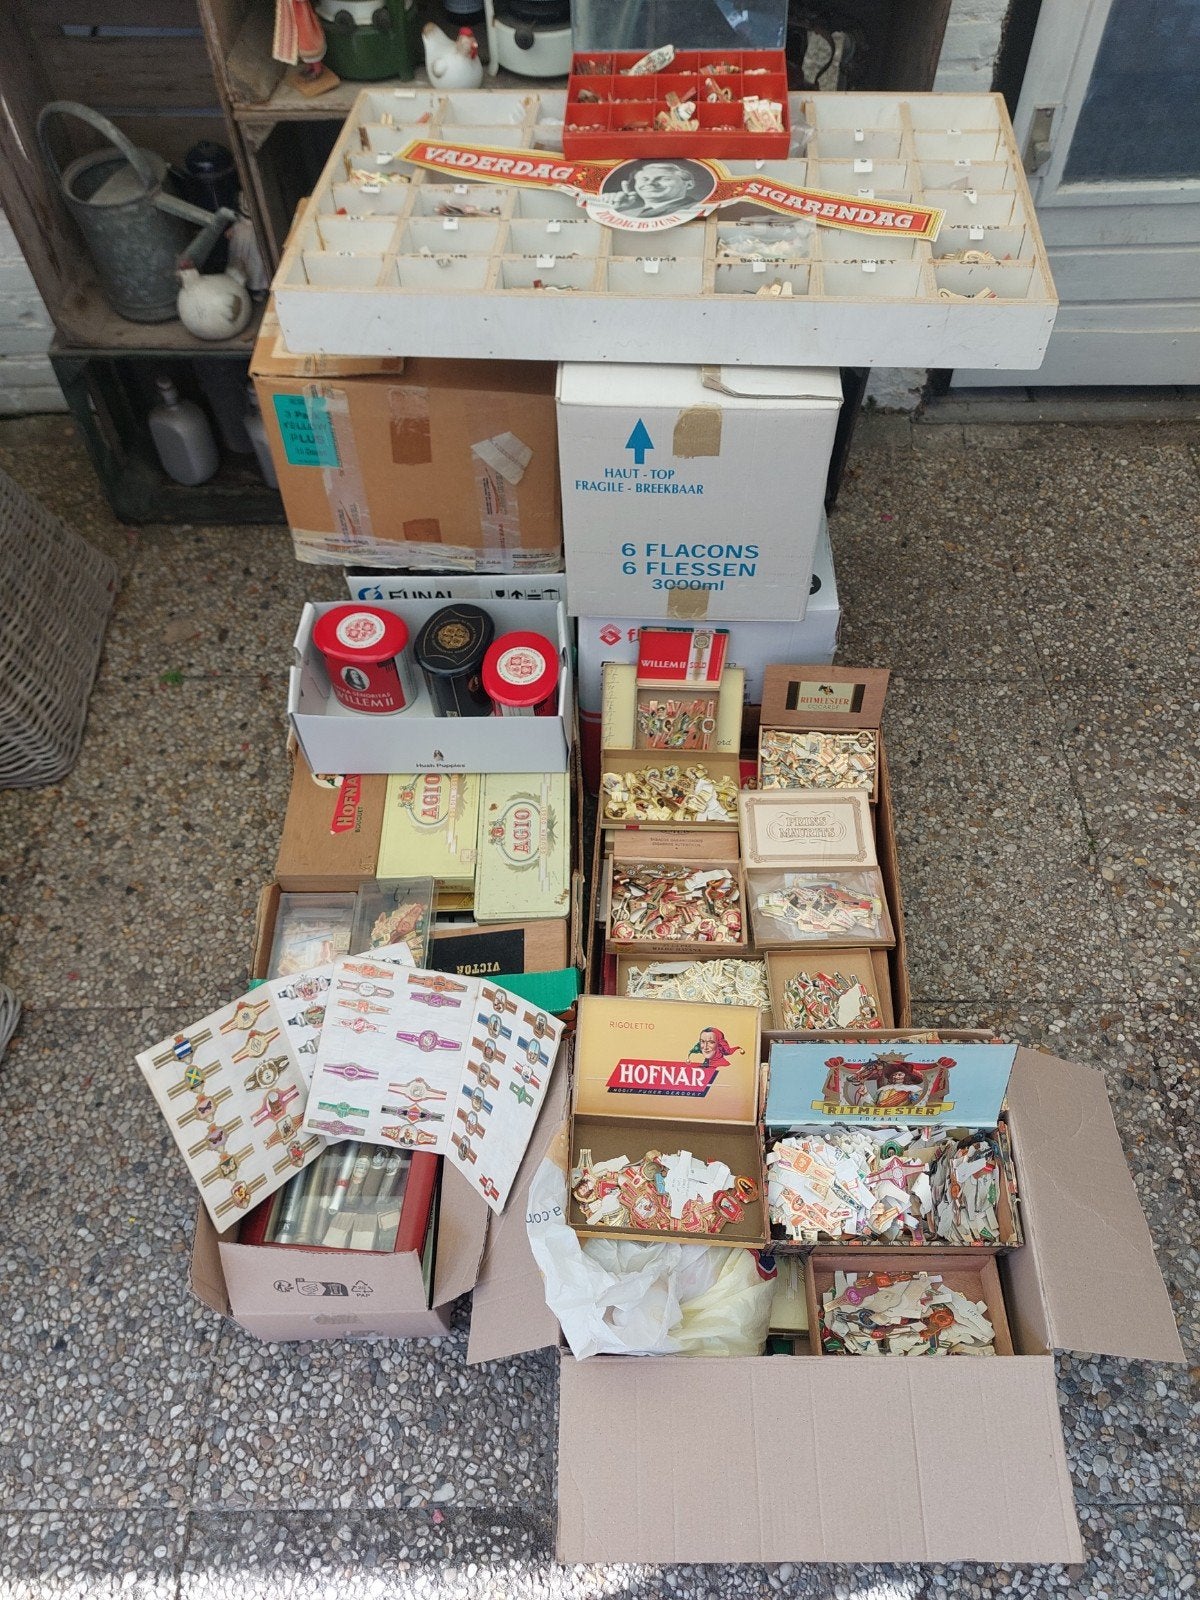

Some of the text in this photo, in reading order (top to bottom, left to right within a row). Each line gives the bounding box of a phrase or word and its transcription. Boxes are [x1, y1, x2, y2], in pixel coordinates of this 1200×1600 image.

[425, 147, 573, 179] VADERDAG
[745, 182, 914, 229] SIGARENDAG
[605, 468, 639, 479] HAUT
[650, 469, 675, 479] TOP
[575, 480, 624, 492] FRAGILE
[636, 483, 704, 494] BREEKBAAR
[622, 543, 759, 559] 6 FLACONS
[622, 561, 756, 577] 6 FLESSEN
[652, 578, 725, 591] 3000ml
[641, 660, 686, 669] WILLEM II
[385, 696, 394, 707] II
[800, 696, 849, 705] RITMEESTER
[336, 774, 359, 826] HOFNA
[421, 773, 442, 819] AGIO
[786, 816, 828, 827] PRINS
[513, 808, 531, 854] AGIO
[778, 827, 835, 838] MAURITS
[456, 961, 501, 975] VICTOR
[609, 1021, 655, 1030] RIGOLETTO
[619, 1063, 706, 1087] HOFNAR
[828, 1106, 936, 1116] RITMEESTER
